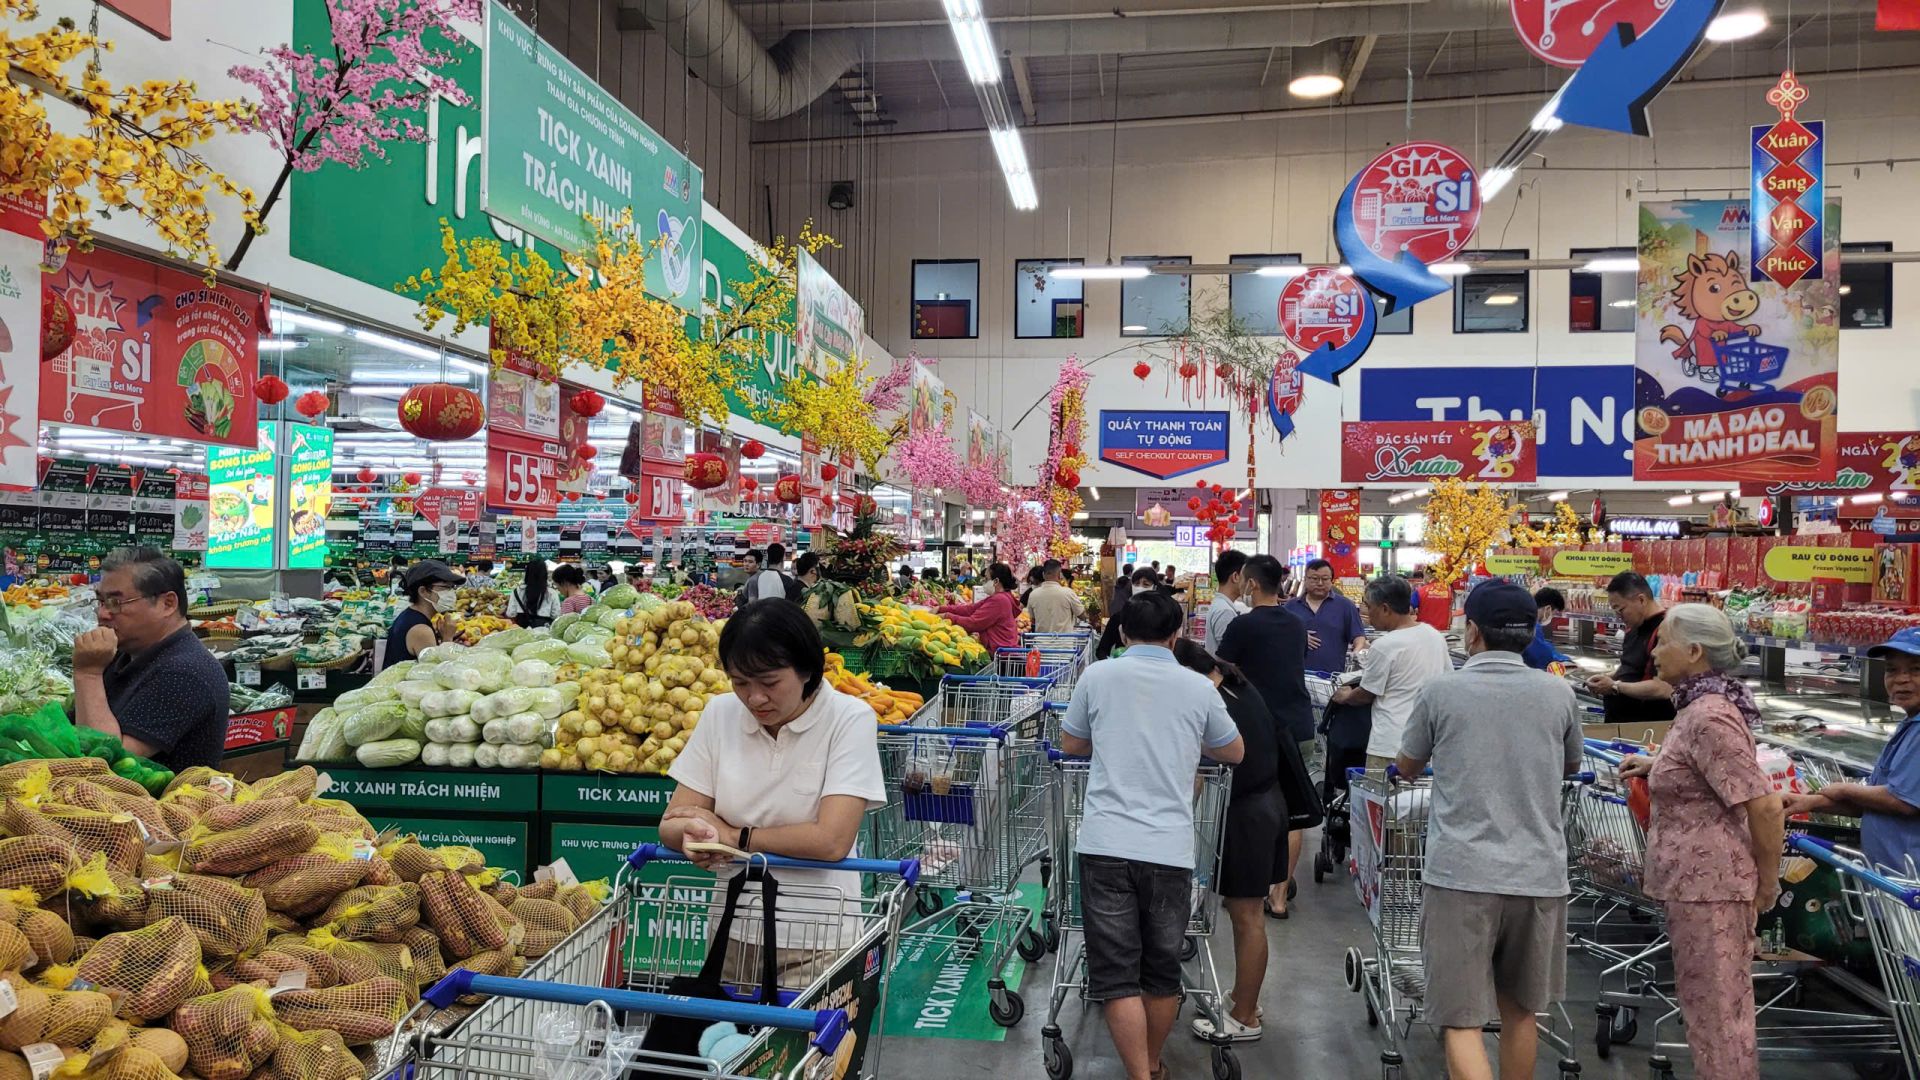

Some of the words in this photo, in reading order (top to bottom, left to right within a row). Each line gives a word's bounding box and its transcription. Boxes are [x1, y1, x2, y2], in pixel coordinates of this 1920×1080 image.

[498, 19, 514, 42] KHU
[516, 33, 533, 57] VỰC
[558, 66, 572, 86] BÀY
[619, 116, 639, 142] DOANH
[547, 80, 567, 104] THAM
[567, 97, 580, 115] GIA
[1767, 132, 1809, 149] Xuân
[538, 107, 581, 166] TICK
[586, 142, 632, 199] XANH
[1391, 151, 1444, 178] GIÁ
[523, 151, 587, 216] TRÁCH
[1435, 171, 1472, 213] SỈ
[1768, 176, 1807, 192] Sang
[1425, 214, 1439, 223] Get
[1440, 214, 1459, 222] More
[1771, 216, 1803, 233] Vạn
[1767, 254, 1807, 272] Phúc
[66, 288, 116, 322] GIÁ
[176, 291, 195, 309] CHỢ
[209, 291, 232, 311] HIỆN
[233, 302, 250, 328] ĐẠI
[1334, 288, 1359, 317] SỈ
[122, 332, 151, 383] SỈ
[114, 381, 125, 391] Get
[126, 382, 143, 393] More
[1145, 420, 1185, 432] THANH
[1188, 417, 1222, 431] TOÁN
[1728, 407, 1786, 434] ĐÁO
[1137, 434, 1155, 447] TỰ
[1158, 432, 1192, 447] ĐỘNG
[1376, 433, 1400, 446] ĐẶC
[1404, 431, 1426, 444] SẢN
[1430, 431, 1452, 444] TẾT
[1654, 437, 1745, 464] THÀNH
[1748, 429, 1816, 456] DEAL
[210, 457, 240, 471] SONG
[241, 450, 272, 465] LONG
[1115, 451, 1134, 460] SELF
[1135, 452, 1177, 460] CHECKOUT
[1178, 452, 1213, 460] COUNTER
[1841, 443, 1879, 457] NGÀY
[1366, 445, 1464, 480] Xuân
[508, 455, 541, 503] 55
[654, 478, 672, 516] 31
[1179, 531, 1190, 541] 10
[1610, 519, 1680, 535] HIMALAYA
[1587, 554, 1600, 562] TÂY
[1792, 553, 1811, 561] RAU
[1814, 551, 1827, 562] CỦ
[1829, 551, 1860, 562] ĐÔNG
[1834, 565, 1867, 573] Vegetables
[327, 781, 350, 794] CK
[354, 781, 396, 795] XANH
[400, 779, 449, 797] TRÁCH
[453, 782, 501, 802] NHIỆM
[578, 787, 613, 801] TICK
[617, 788, 661, 803] XANH
[431, 832, 450, 842] CỦA
[452, 834, 483, 844] DOANH
[484, 835, 517, 847] NGHIỆP
[561, 839, 579, 848] KHU
[581, 839, 599, 850] VỰC
[601, 839, 629, 850] TRƯNG
[640, 887, 708, 909] XANH
[648, 914, 709, 945] NHIỆ
[930, 963, 971, 996] XANH
[914, 997, 957, 1029] TICK
